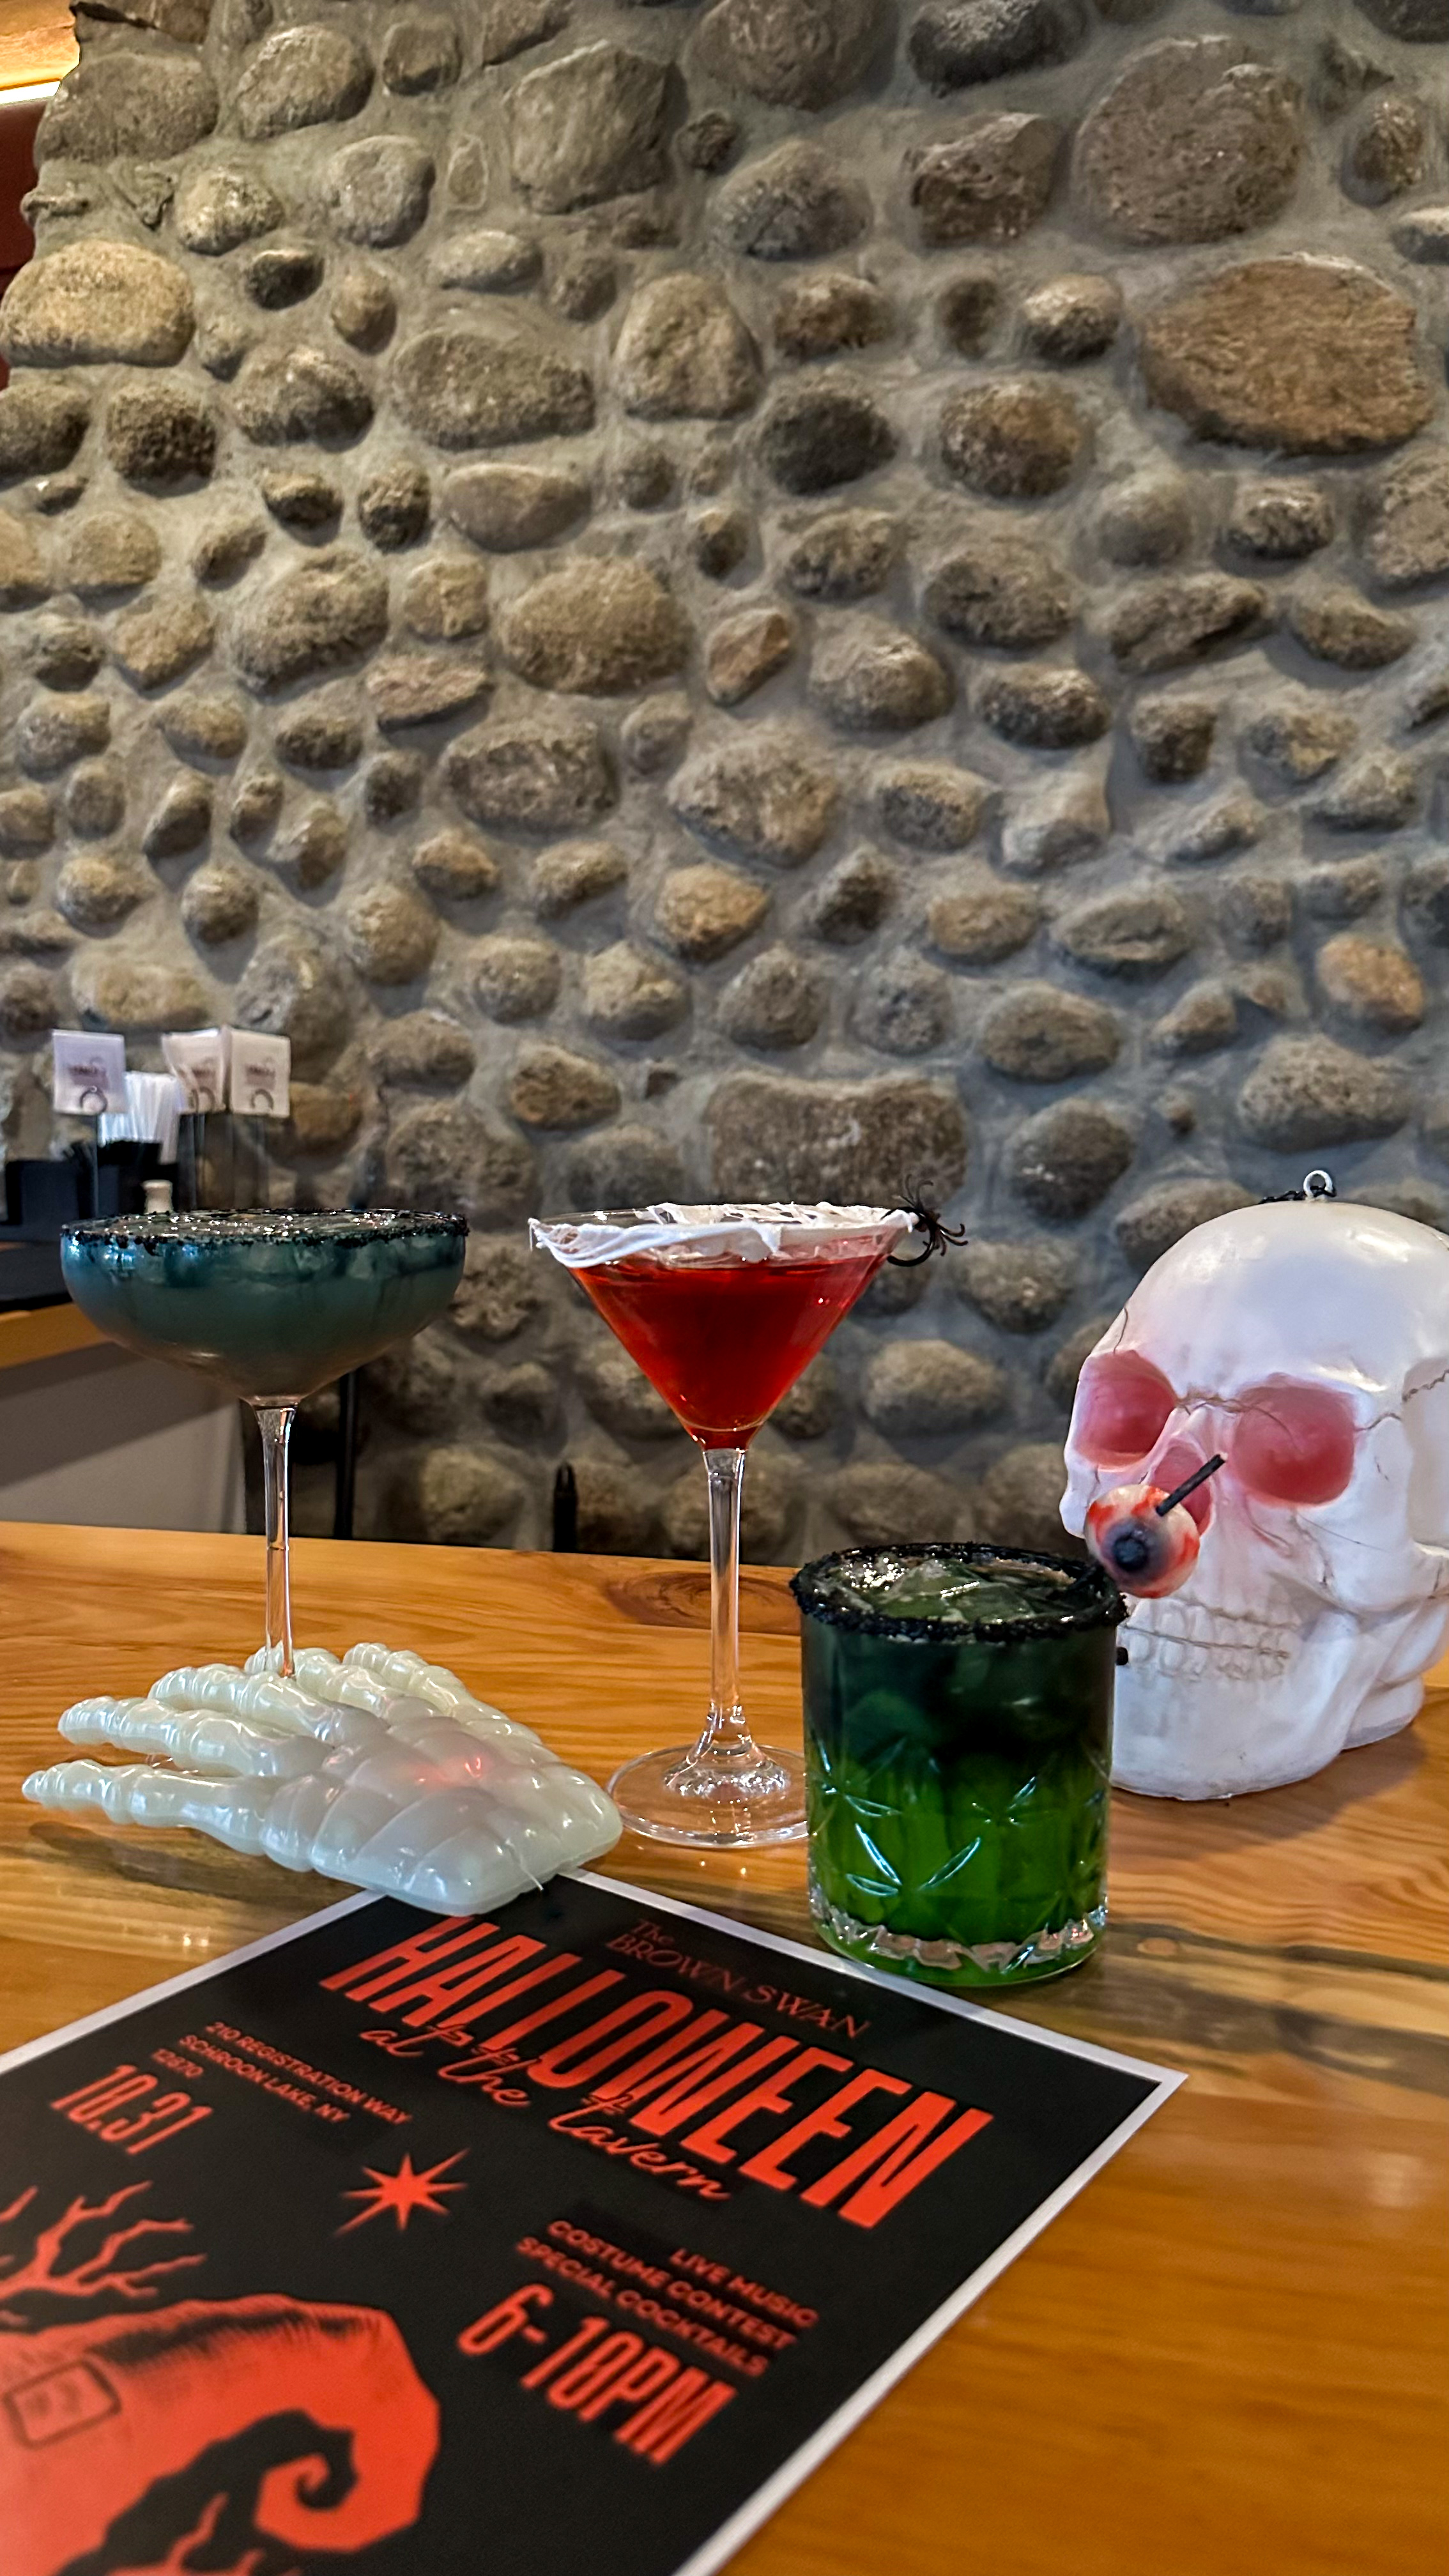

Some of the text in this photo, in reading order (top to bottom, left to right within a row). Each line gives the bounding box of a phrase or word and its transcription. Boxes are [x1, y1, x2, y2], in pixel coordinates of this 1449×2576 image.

[631, 1919, 675, 1945] The
[605, 1933, 873, 2039] BROWN SWAN
[50, 2064, 213, 2156] 10.31
[179, 2034, 270, 2085] SCHROON
[315, 2103, 351, 2124] NY
[205, 2021, 413, 2126] 210 REGISTRATION WAY
[319, 1917, 994, 2229] HALLOWEEN
[358, 2023, 542, 2107] at the
[547, 2093, 733, 2199] tavern
[516, 2236, 769, 2378] SPECIAL COCKTAILS
[547, 2220, 797, 2350] COSTUME CONTEST
[669, 2248, 819, 2329] LIVE MUSIC
